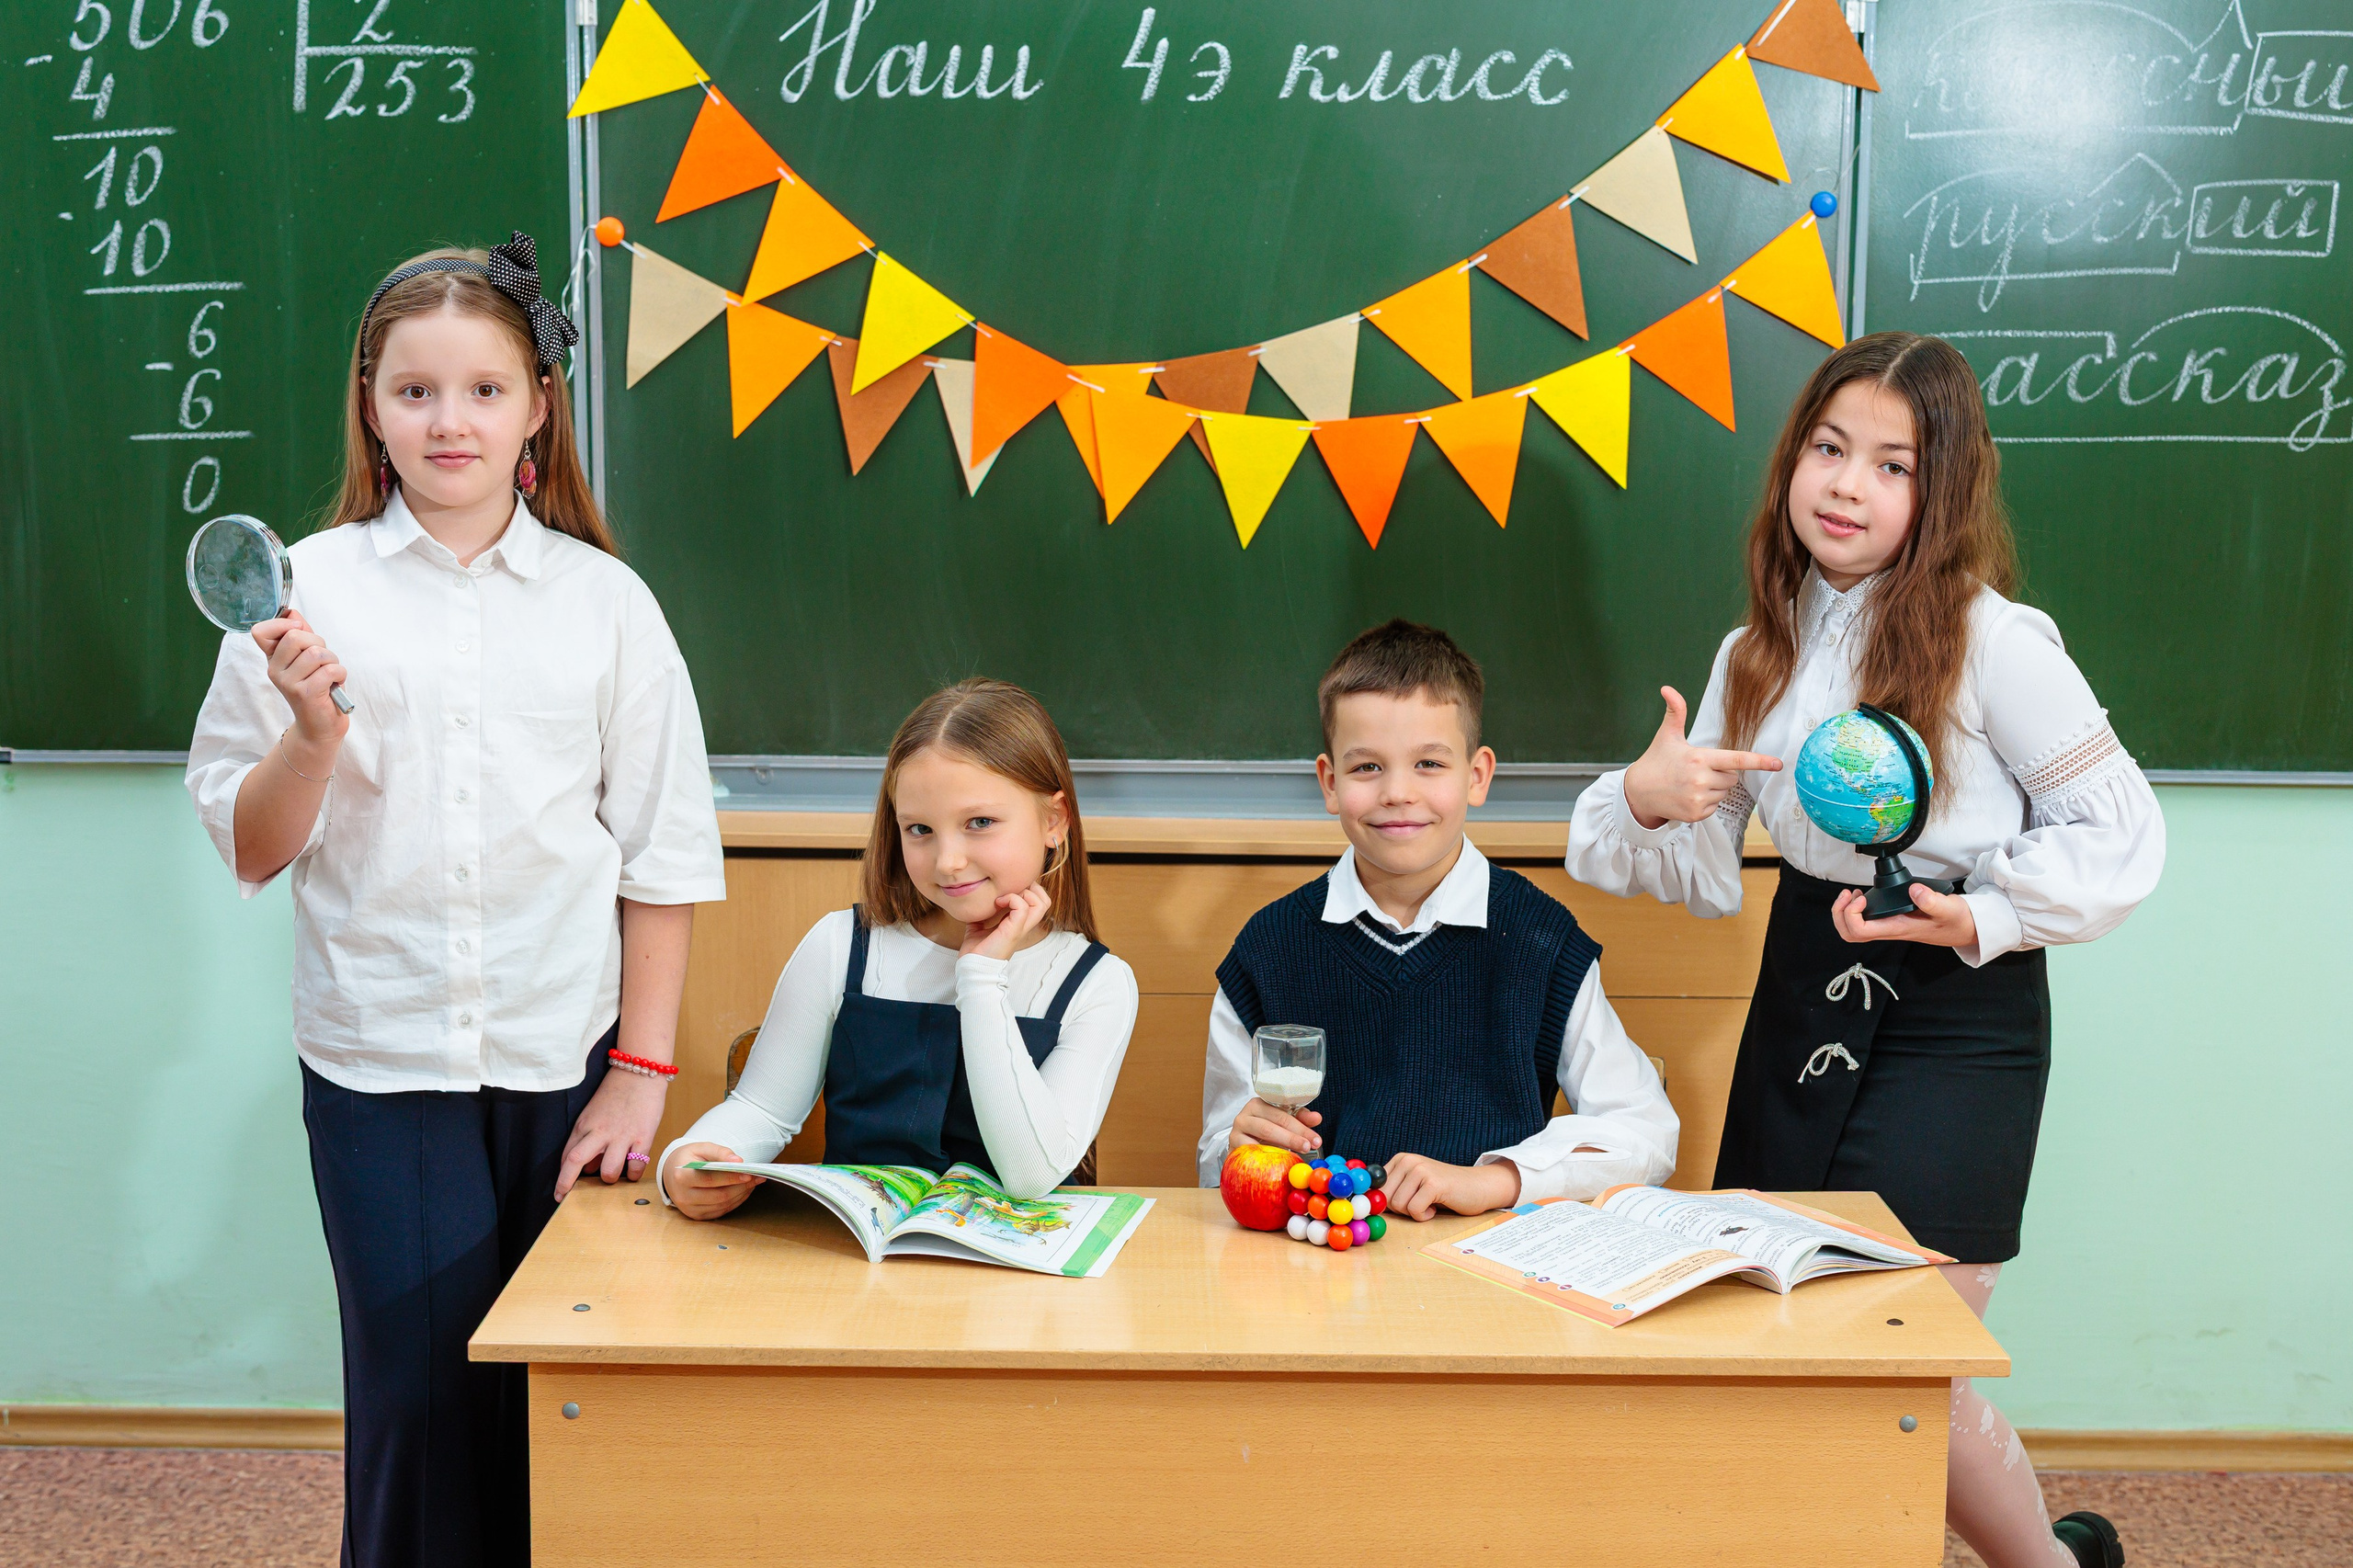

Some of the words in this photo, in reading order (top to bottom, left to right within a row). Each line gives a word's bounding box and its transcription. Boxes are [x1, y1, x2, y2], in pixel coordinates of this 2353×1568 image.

[68, 0, 230, 51] 506
[351, 0, 395, 43] 2
[779, 0, 1044, 104] Наш
[1279, 43, 1574, 106] класс
[68, 55, 115, 121] 4
[324, 56, 476, 123] 253
[84, 145, 164, 210] 10
[90, 218, 171, 276] 10
[1909, 185, 2321, 313] русский
[188, 301, 225, 358] 6
[178, 369, 222, 430] 6
[1967, 347, 2353, 452] ассказ
[183, 456, 221, 515] 0
